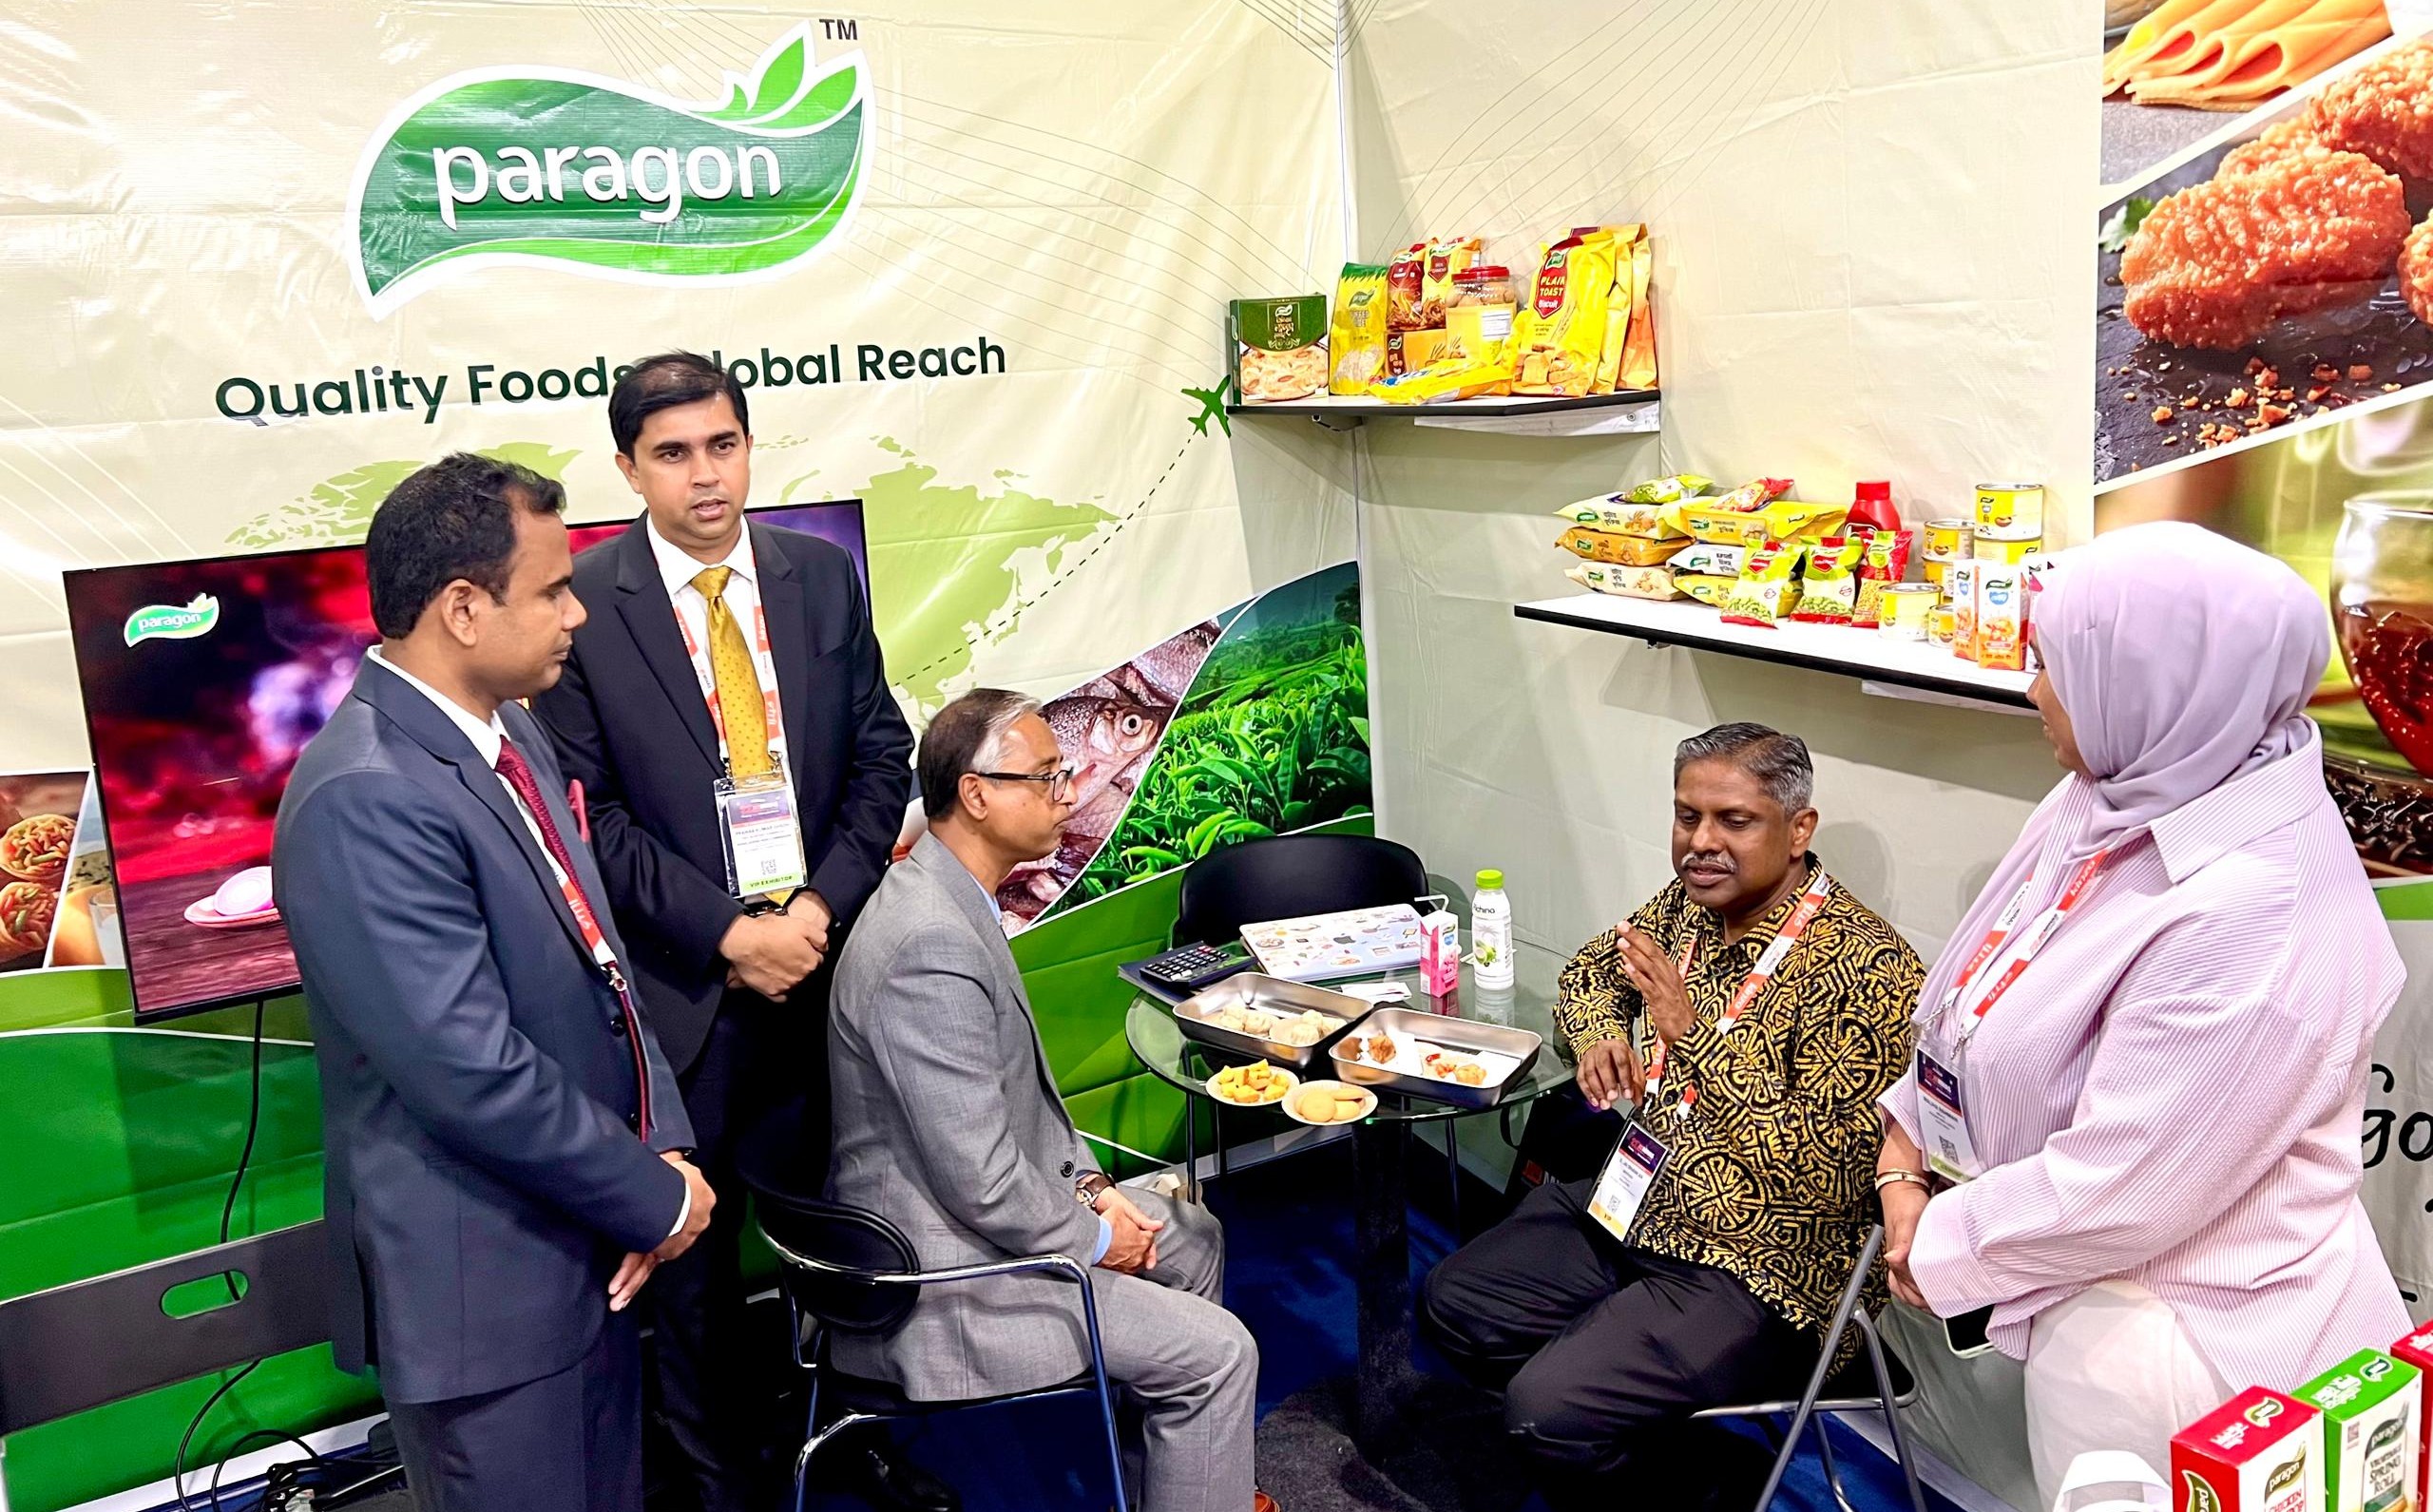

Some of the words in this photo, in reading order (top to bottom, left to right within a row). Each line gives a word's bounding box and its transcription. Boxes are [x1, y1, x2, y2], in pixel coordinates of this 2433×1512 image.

[819, 18, 859, 41] TM
[432, 144, 782, 231] paragon
[1540, 287, 1564, 297] TOAST
[215, 366, 449, 427] Quality
[713, 344, 841, 389] lobal
[857, 336, 1006, 382] Reach
[138, 614, 201, 633] paragon
[2270, 1462, 2300, 1493] paragon
